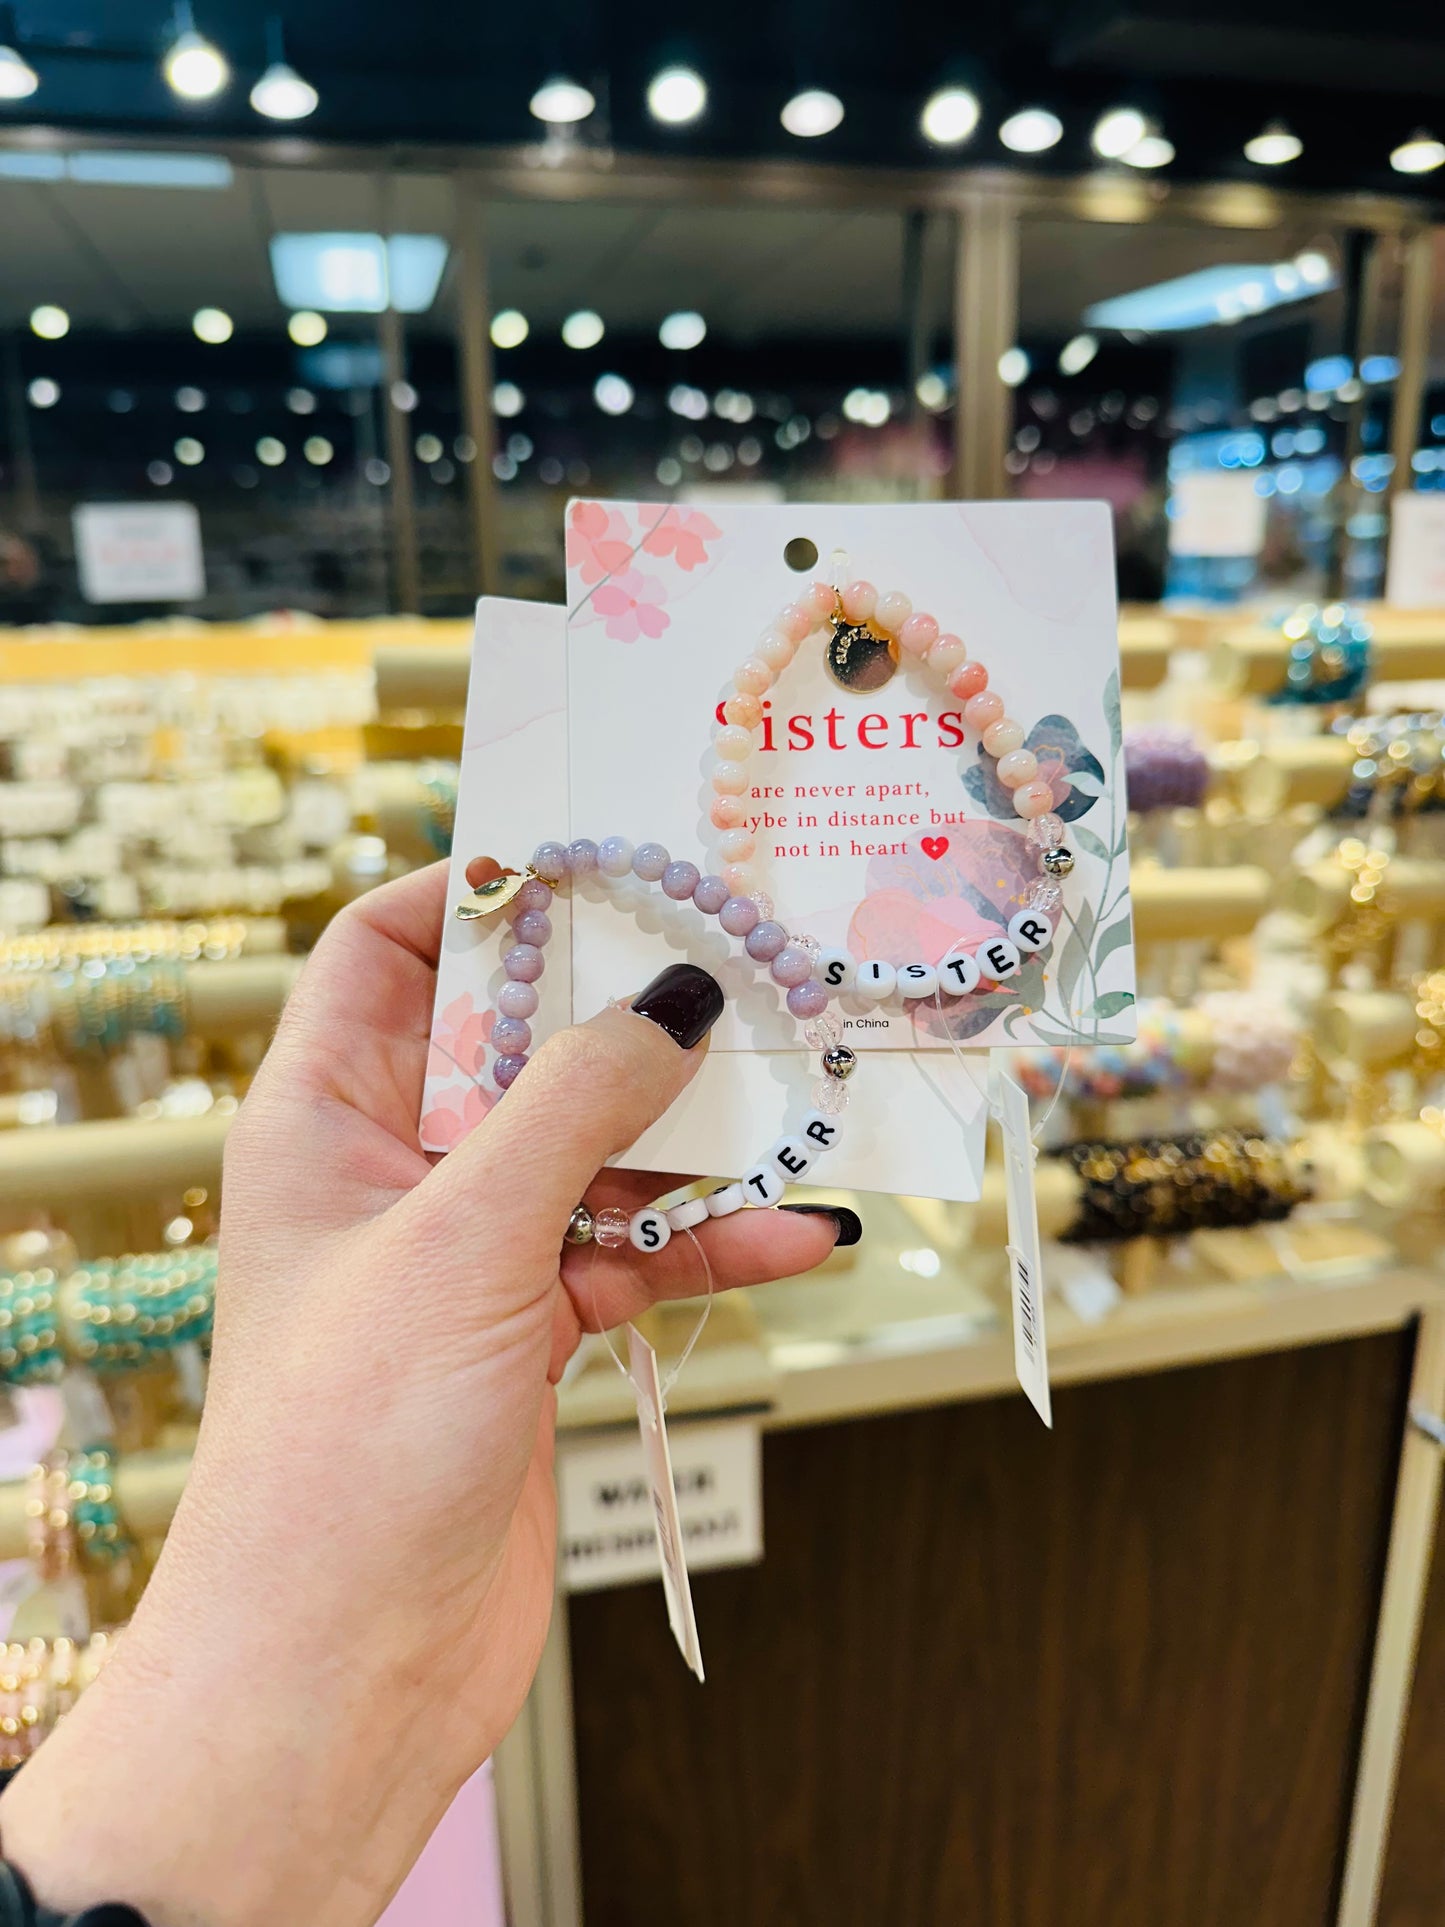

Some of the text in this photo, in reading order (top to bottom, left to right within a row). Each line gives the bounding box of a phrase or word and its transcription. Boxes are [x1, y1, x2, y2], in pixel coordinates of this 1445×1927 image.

[751, 781, 930, 802] are never apart,
[741, 809, 967, 834] ybe in distance but
[774, 838, 909, 857] not in heart
[824, 919, 1047, 985] SISTER
[842, 1018, 890, 1029] in China
[640, 1120, 835, 1247] STER
